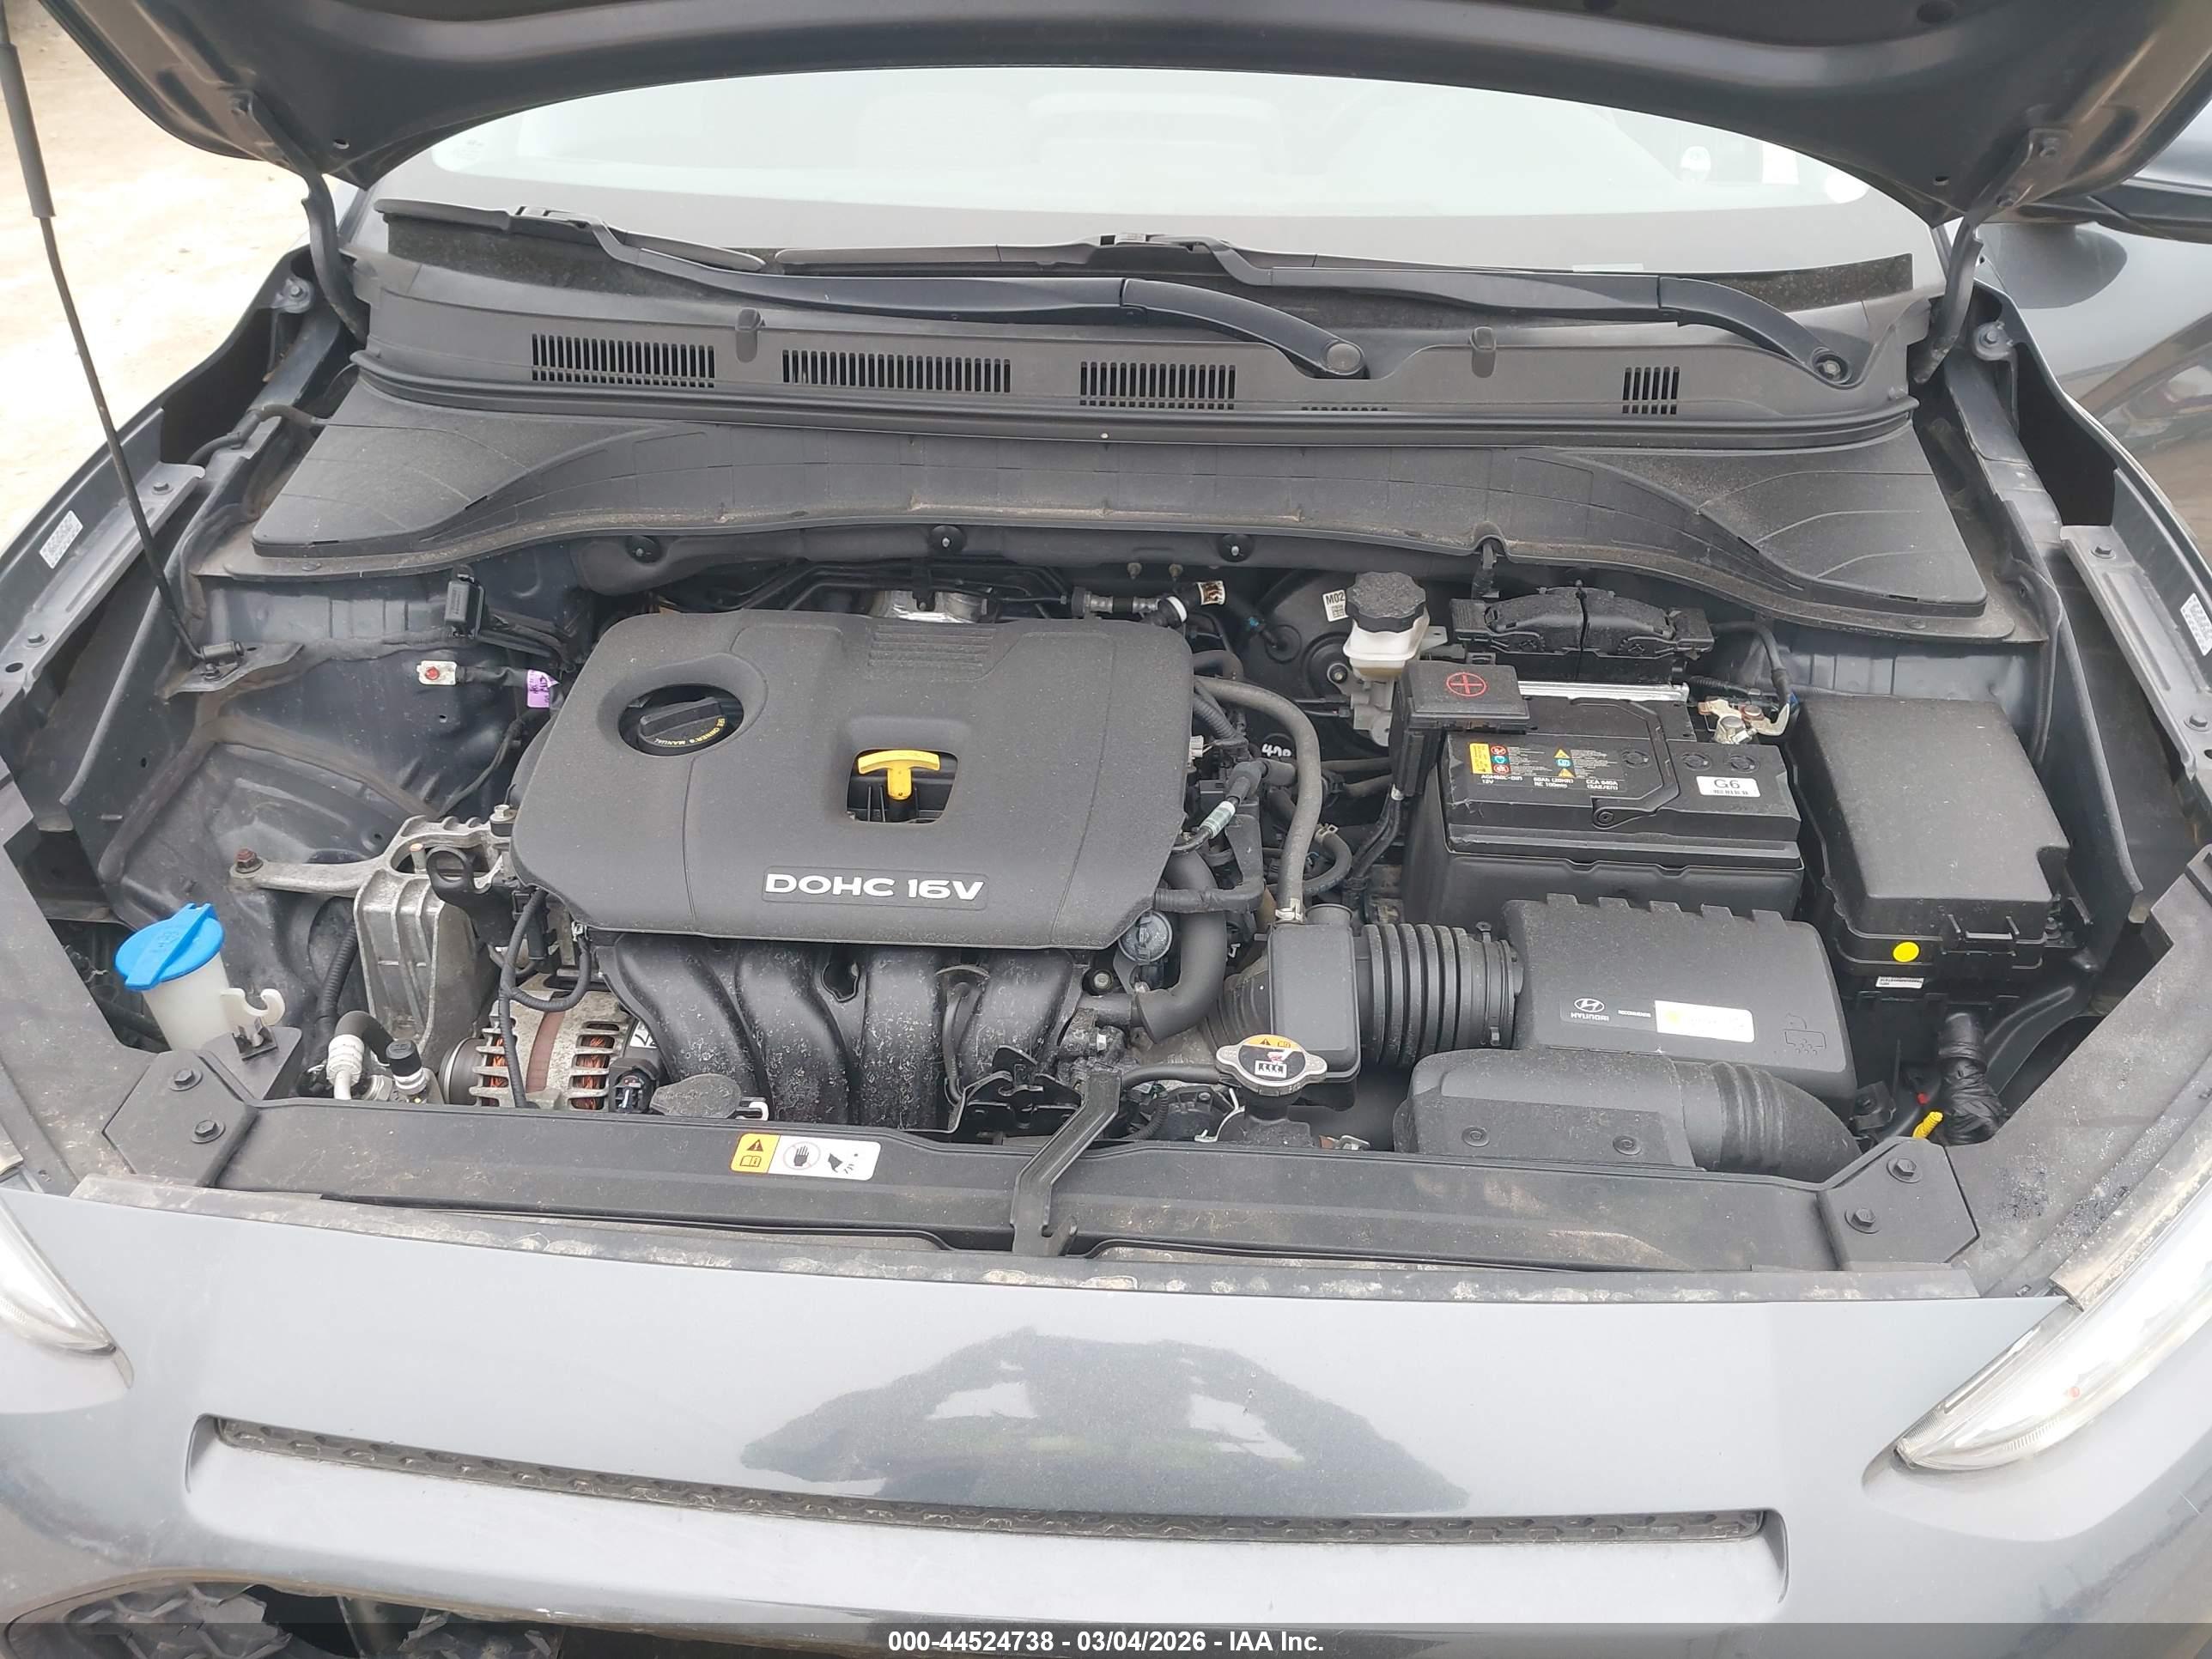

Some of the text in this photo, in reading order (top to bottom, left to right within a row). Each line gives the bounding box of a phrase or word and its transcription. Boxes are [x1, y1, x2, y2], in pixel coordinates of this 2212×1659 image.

[1325, 592, 1346, 605] M02
[1714, 779, 1741, 789] G6
[765, 873, 984, 900] DOHC 16V
[1571, 1012, 1609, 1022] HYUNDAI
